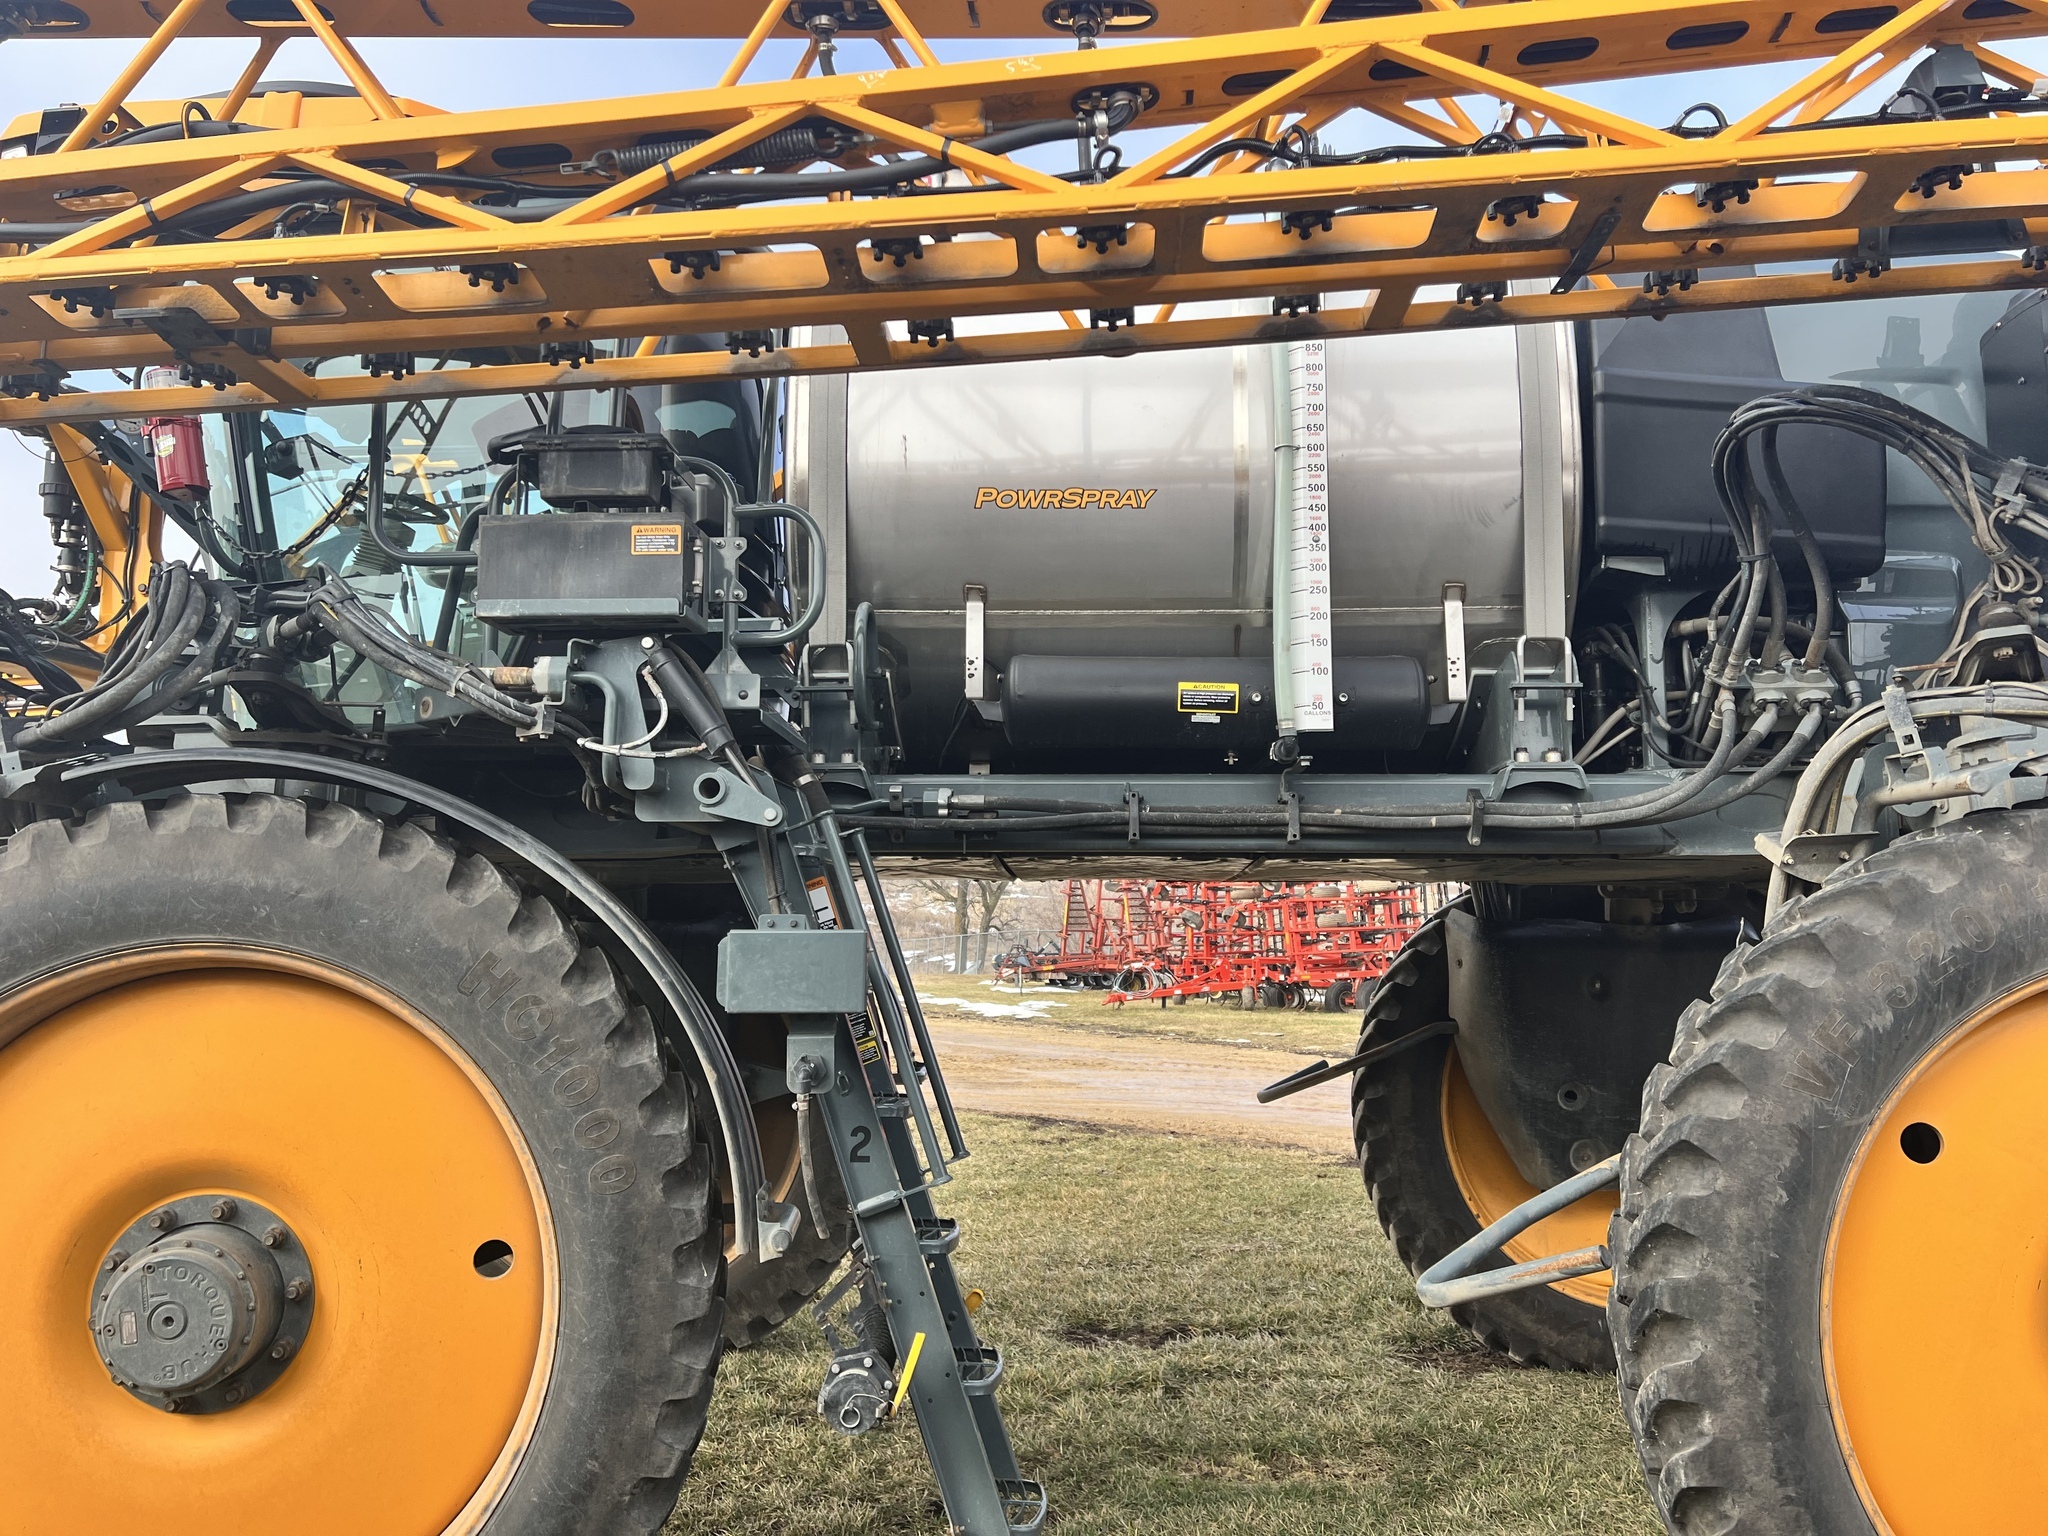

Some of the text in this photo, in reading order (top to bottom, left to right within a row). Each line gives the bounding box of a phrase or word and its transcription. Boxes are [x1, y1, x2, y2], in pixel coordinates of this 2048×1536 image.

[1309, 586, 1327, 594] 250
[1310, 612, 1328, 620] 200
[1311, 667, 1328, 675] 100
[1312, 702, 1323, 710] 50
[1781, 1008, 1862, 1101] VF
[850, 1125, 871, 1163] 2
